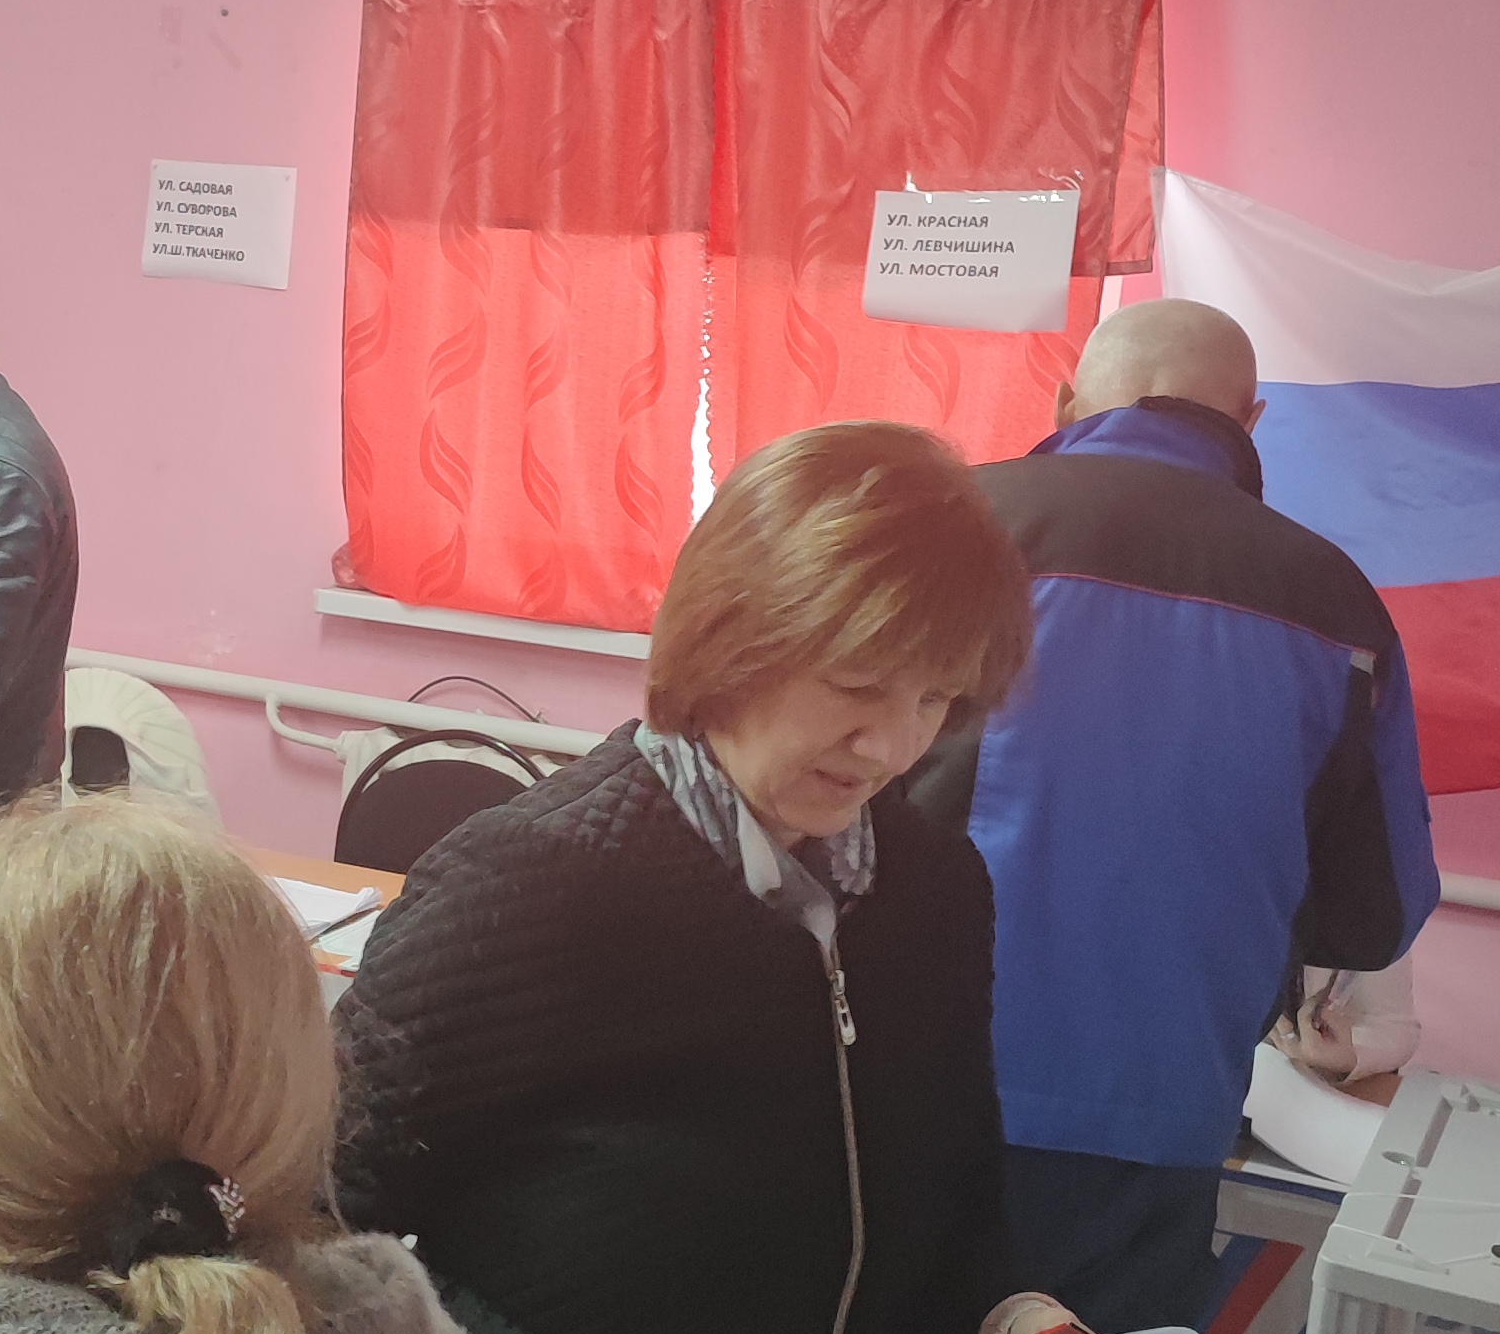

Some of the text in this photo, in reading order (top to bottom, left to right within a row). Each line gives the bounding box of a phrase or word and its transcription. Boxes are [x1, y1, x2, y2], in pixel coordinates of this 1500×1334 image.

[158, 180, 233, 196] УЛ. САДОВАЯ
[156, 200, 237, 218] УЛ. СУВОРОВА
[887, 214, 989, 228] УЛ. КРАСНАЯ
[154, 222, 224, 238] УЛ. ТЕРСКАЯ
[883, 238, 1015, 254] УЛ. ЛЕВЧИШИНА
[879, 263, 999, 278] УЛ. МОСТОВАЯ
